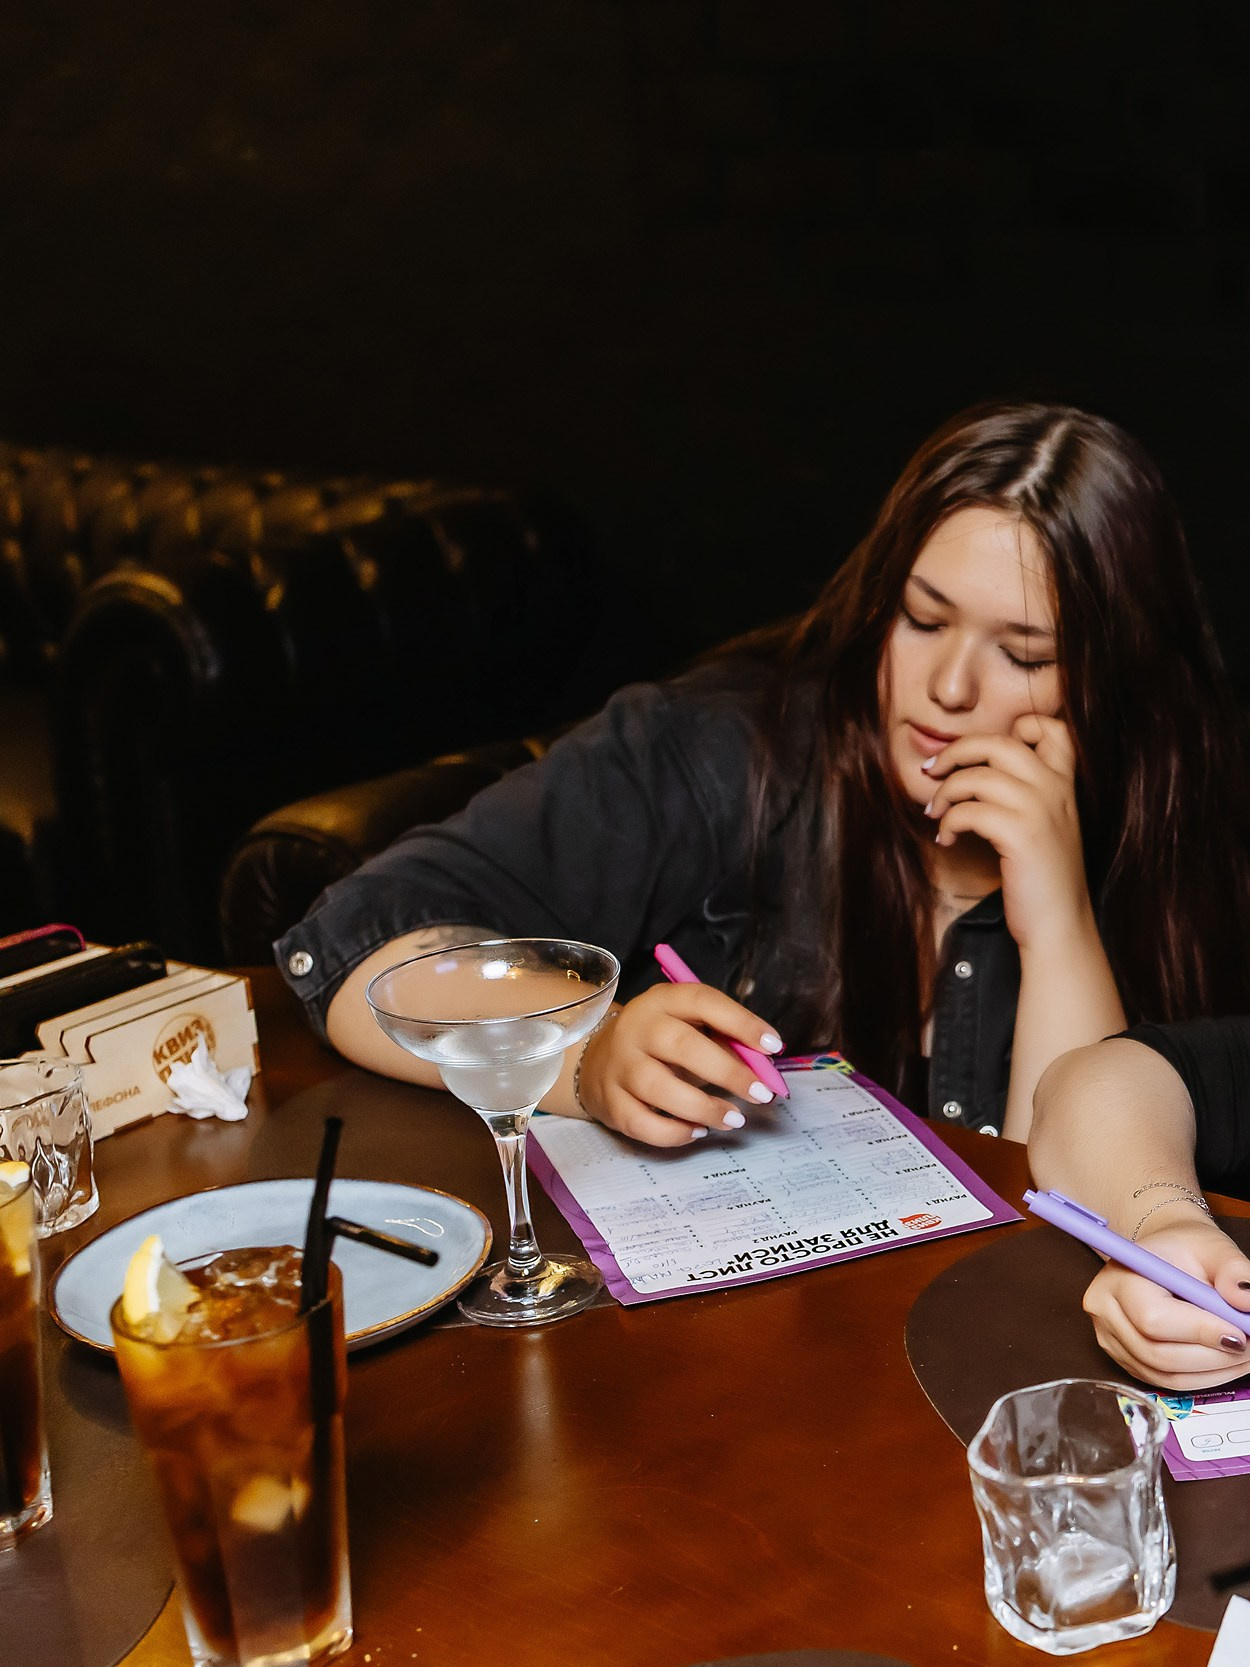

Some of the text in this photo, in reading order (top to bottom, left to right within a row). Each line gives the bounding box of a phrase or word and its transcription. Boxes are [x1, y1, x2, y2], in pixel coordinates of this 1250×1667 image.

[931, 1193, 968, 1206] РАУНД
[760, 1229, 799, 1243] РАУНД
[839, 1219, 889, 1239] ДЛЯ
[869, 1229, 899, 1242] НЕ
[760, 1236, 865, 1266] ПРОСТО
[686, 1261, 754, 1282] ЛИСТ
